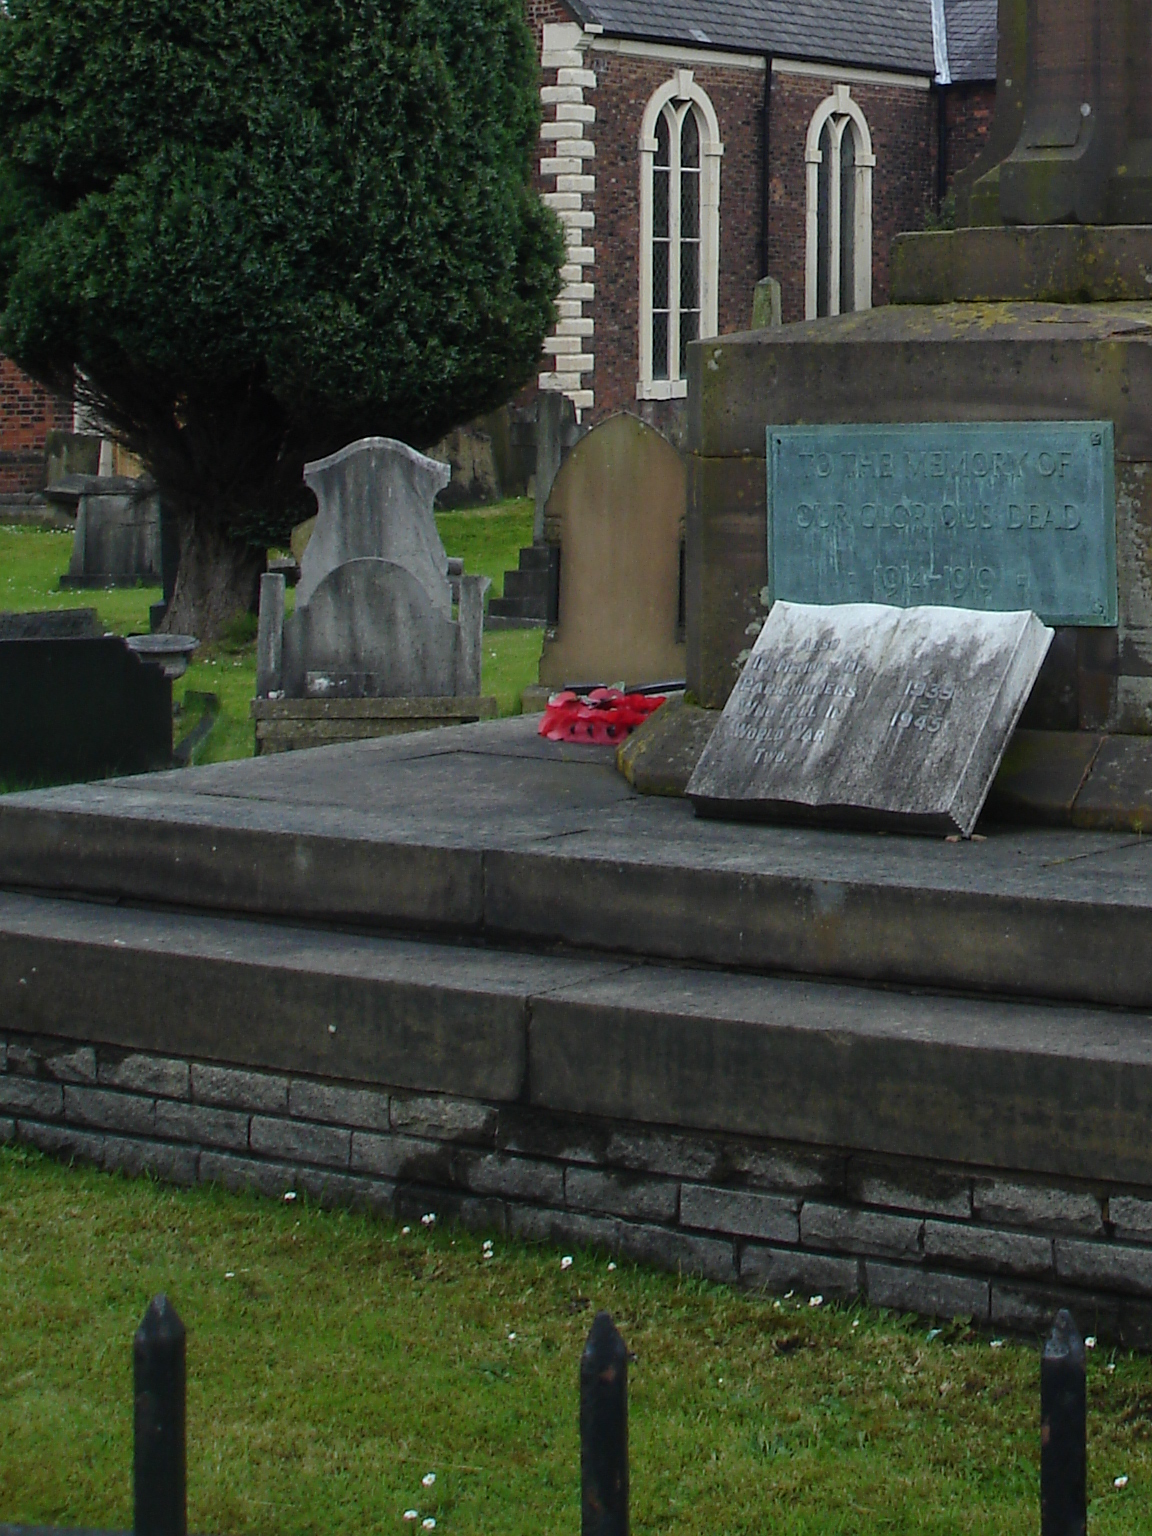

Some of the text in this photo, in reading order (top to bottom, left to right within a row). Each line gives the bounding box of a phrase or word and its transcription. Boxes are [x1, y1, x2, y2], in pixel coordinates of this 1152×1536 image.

[798, 450, 1073, 479] TO THE MEMORY OF
[796, 501, 1082, 531] OUR GLORIOUS DEAD
[796, 637, 841, 652] ALSO
[752, 654, 772, 673] IN
[903, 679, 956, 701] 1939
[825, 704, 847, 720] IN
[890, 710, 944, 733] 1945
[732, 722, 825, 743] WORLD WAR
